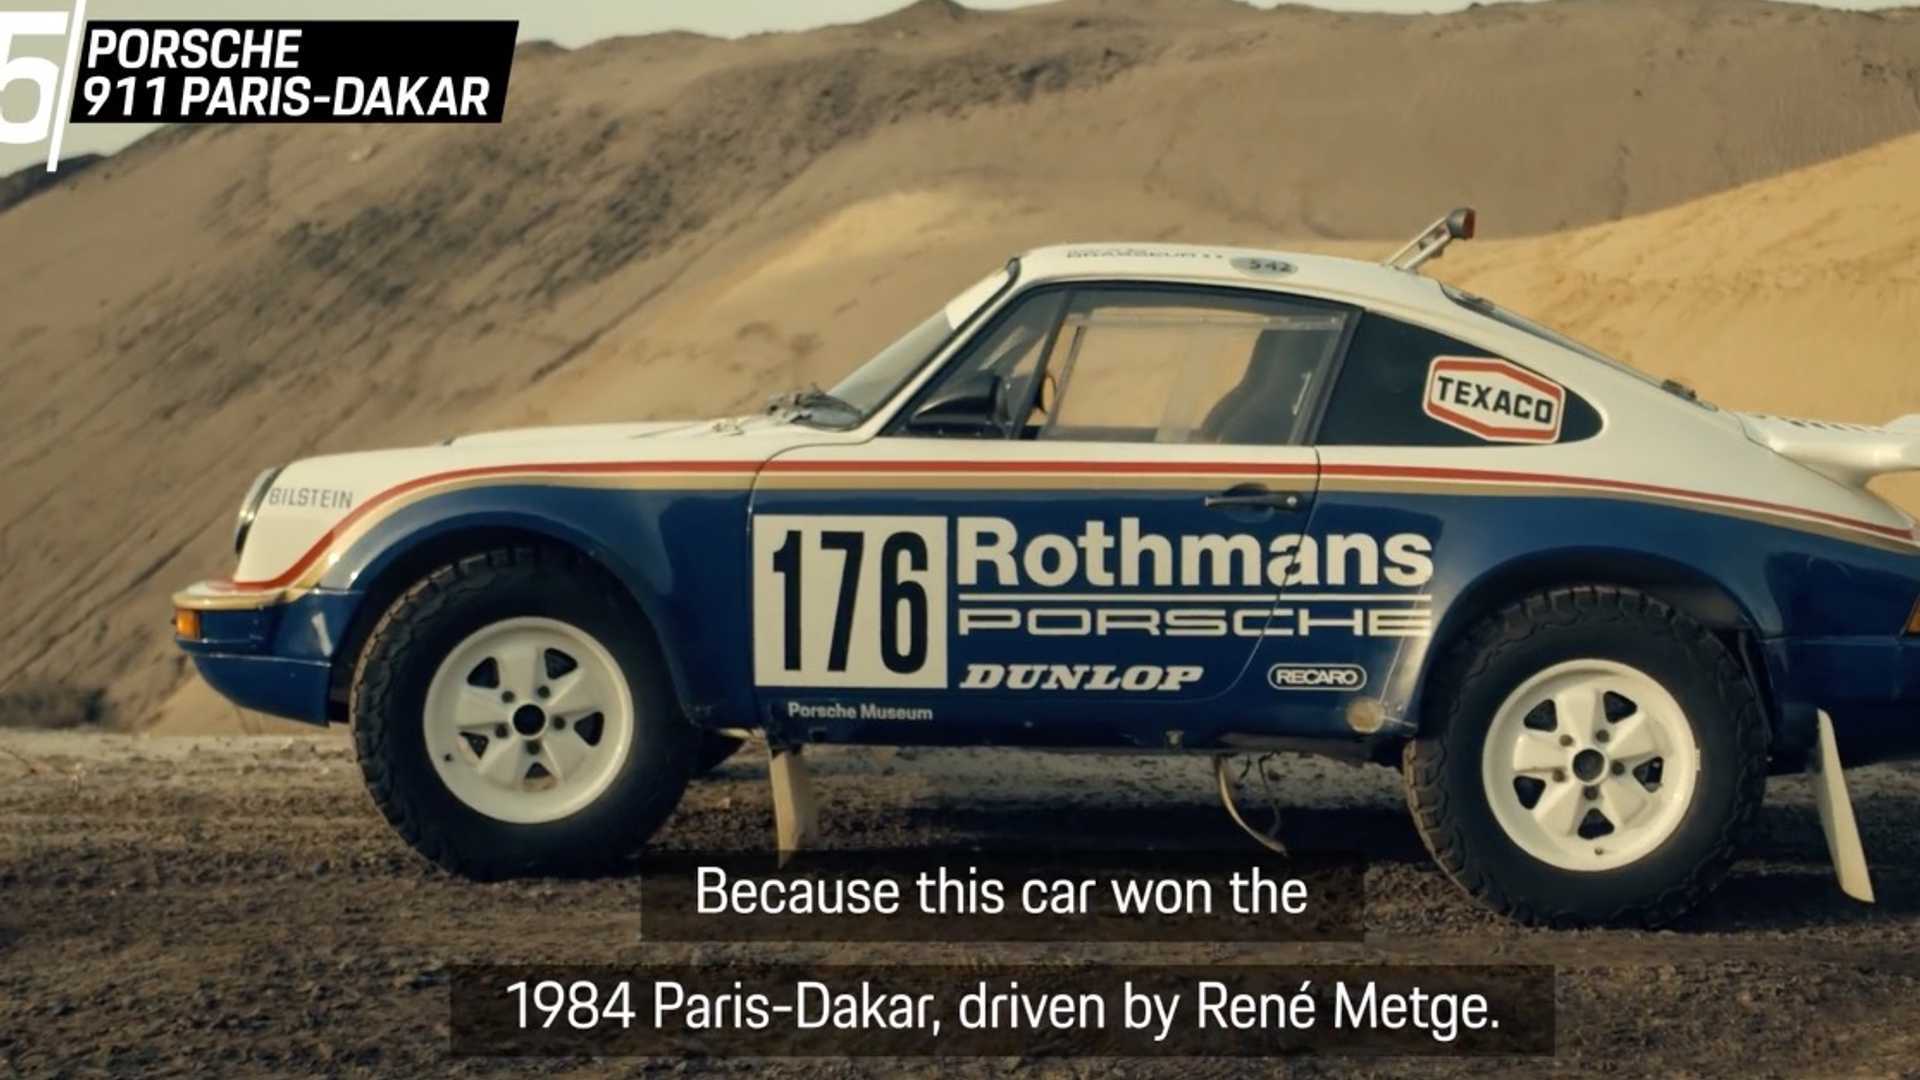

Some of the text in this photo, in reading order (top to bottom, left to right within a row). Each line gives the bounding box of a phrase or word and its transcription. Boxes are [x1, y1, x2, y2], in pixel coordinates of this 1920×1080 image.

[1249, 258, 1293, 272] 542
[1437, 376, 1554, 424] TEXACO
[268, 487, 353, 508] BILSTEIN
[957, 516, 1434, 587] Rothmans
[772, 529, 929, 674] 176
[958, 608, 1433, 636] PORSCHE
[958, 664, 1204, 690] DUNLOP
[1276, 669, 1358, 685] RECARO
[787, 701, 934, 721] Porsche Museum
